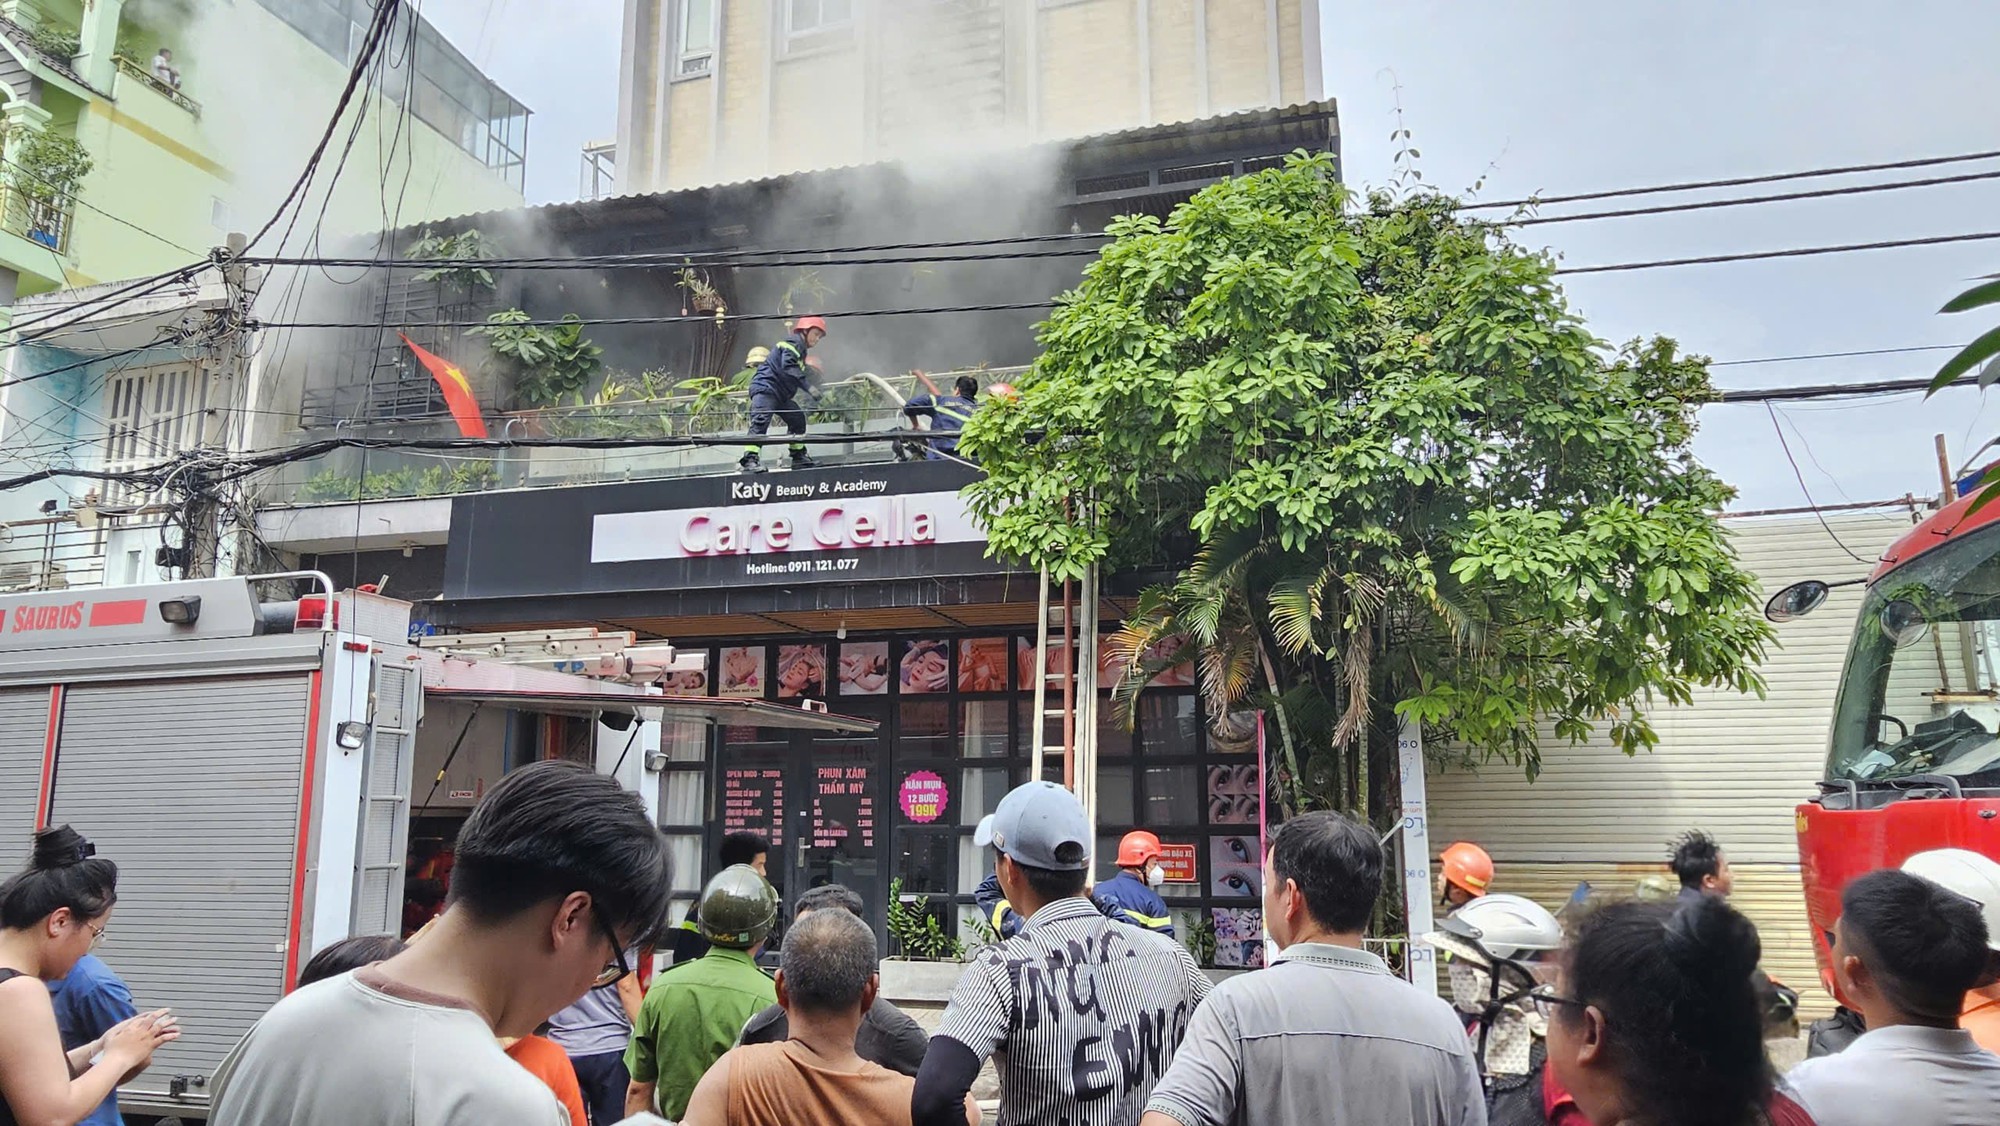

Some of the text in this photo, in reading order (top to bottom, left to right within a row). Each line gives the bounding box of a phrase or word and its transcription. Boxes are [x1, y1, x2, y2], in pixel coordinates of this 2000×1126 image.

[732, 479, 887, 501] Katy Beauty & Academy
[680, 497, 936, 553] Care Cella
[12, 600, 85, 633] SAURUS
[818, 768, 842, 778] PHUN
[908, 794, 917, 803] 12
[909, 803, 937, 817] 199K
